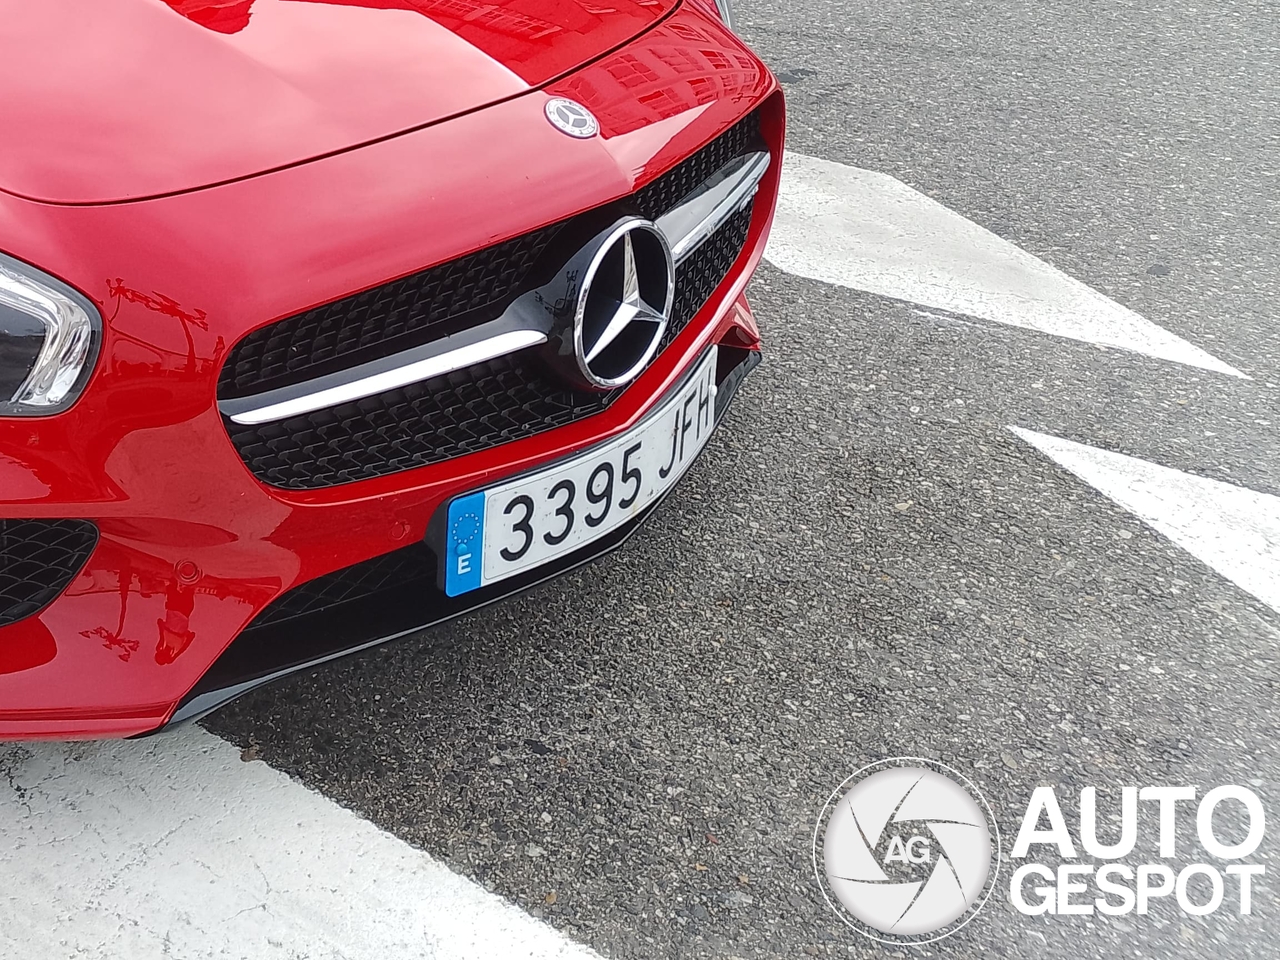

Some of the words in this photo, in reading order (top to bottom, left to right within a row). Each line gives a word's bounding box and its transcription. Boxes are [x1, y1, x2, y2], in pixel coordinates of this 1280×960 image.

[457, 553, 472, 575] E
[499, 440, 643, 563] 3395
[658, 368, 713, 480] JFH
